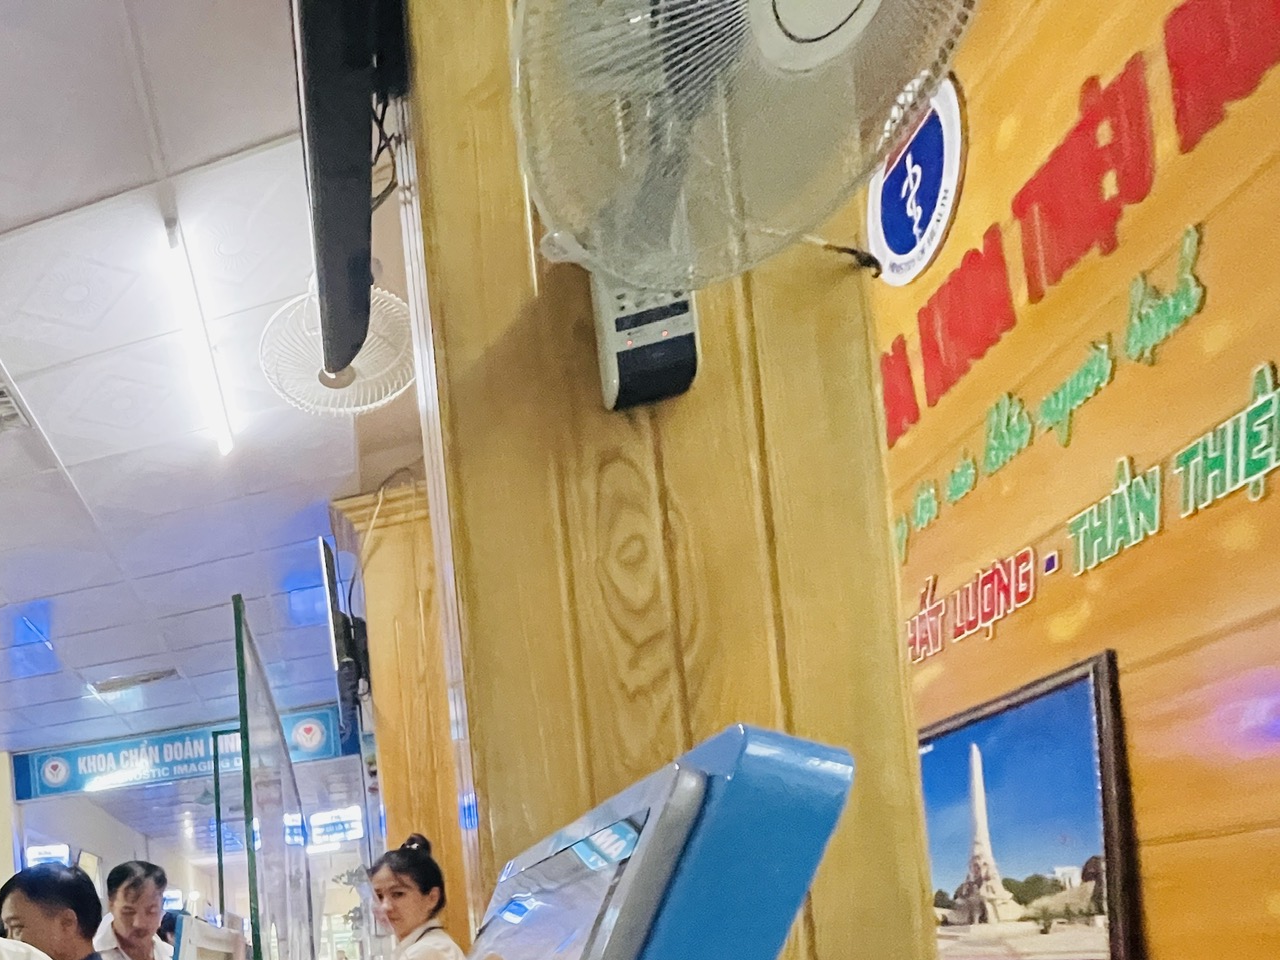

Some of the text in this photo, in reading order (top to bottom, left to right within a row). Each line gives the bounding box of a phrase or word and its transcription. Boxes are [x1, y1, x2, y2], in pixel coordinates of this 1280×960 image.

[1066, 455, 1161, 578] THÂN
[77, 752, 117, 775] KHOA
[163, 737, 205, 763] ĐOÁN
[173, 760, 230, 776] IMAGIG
